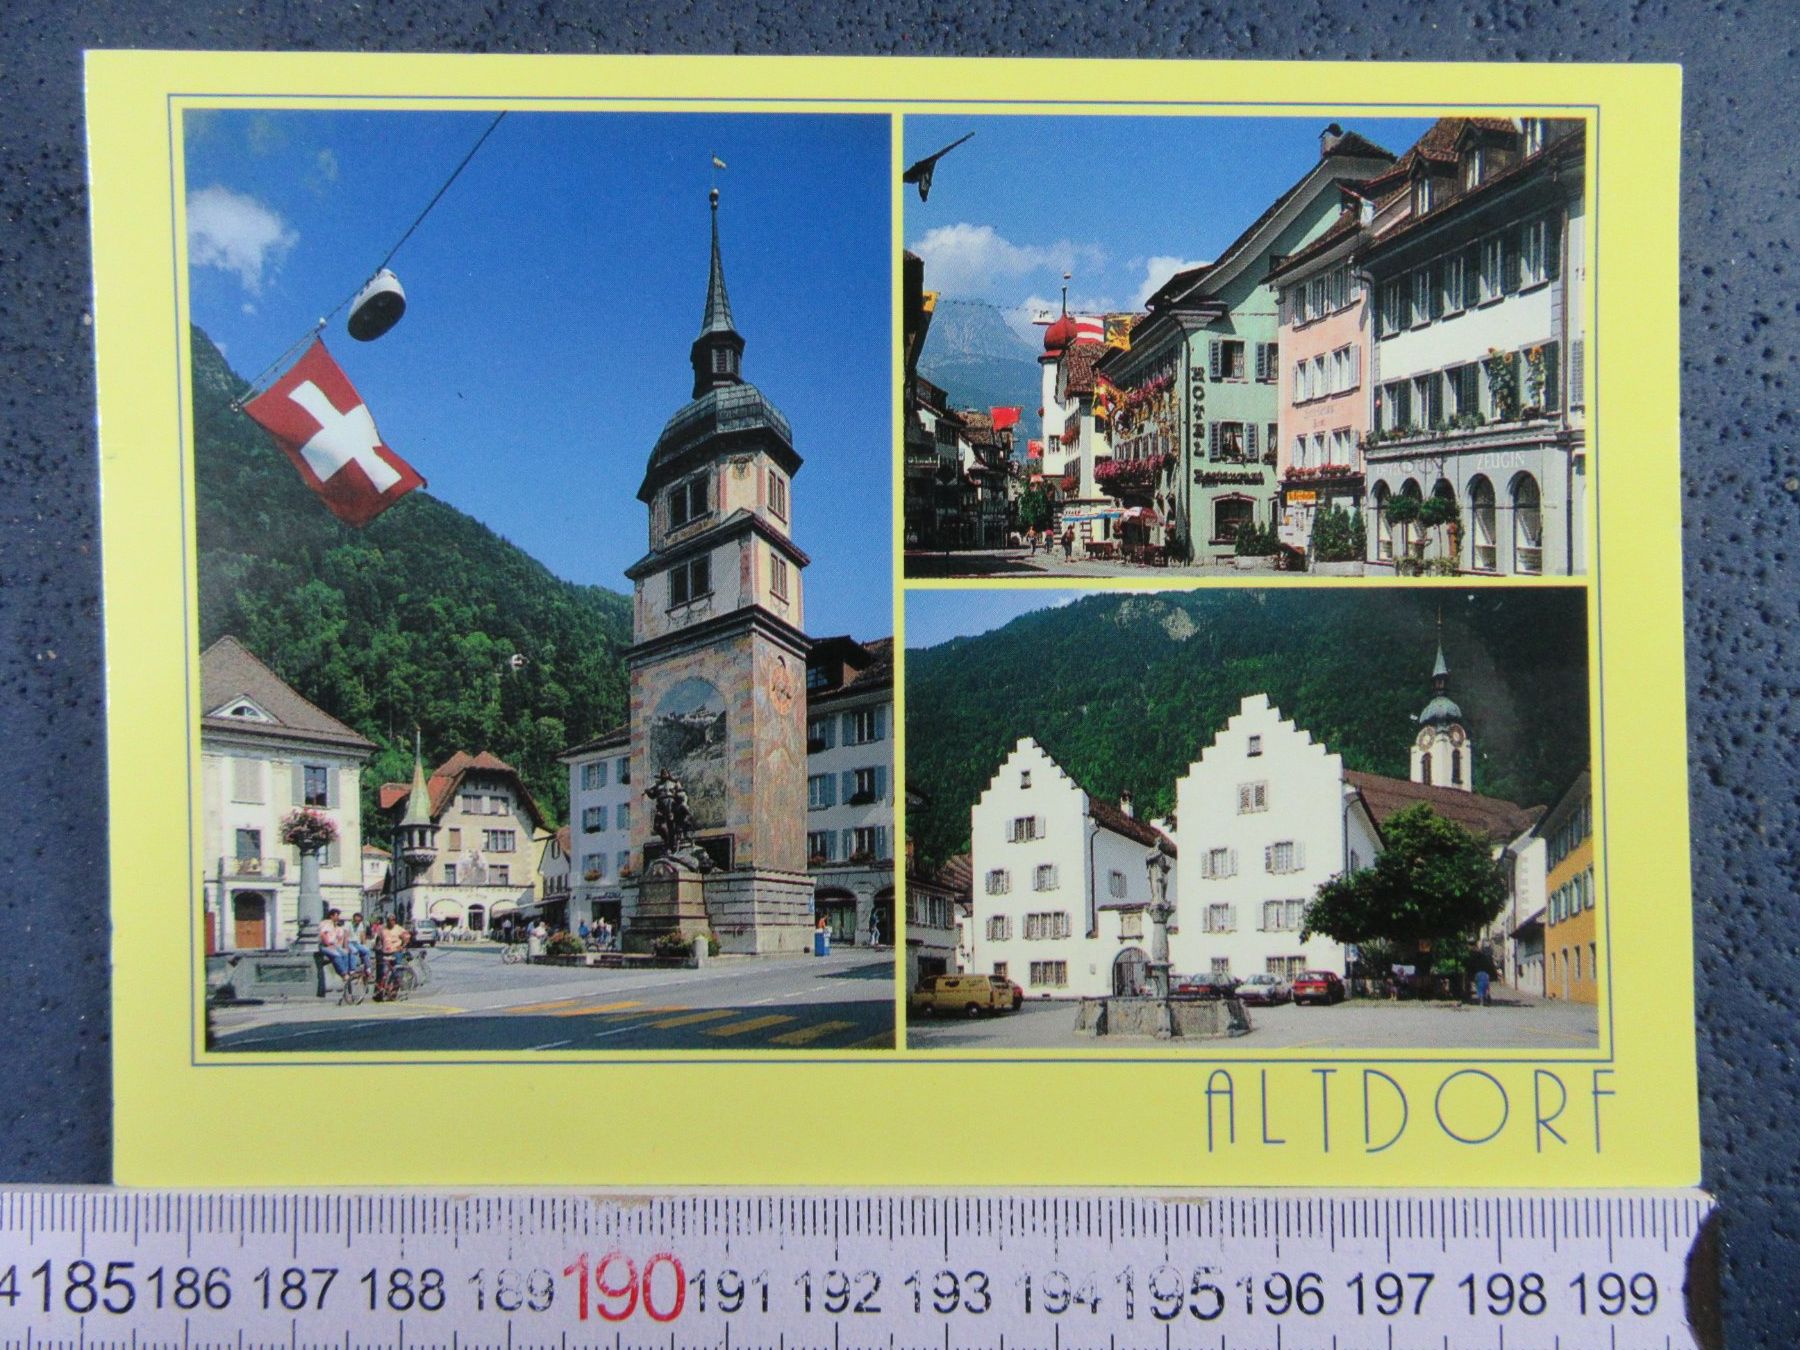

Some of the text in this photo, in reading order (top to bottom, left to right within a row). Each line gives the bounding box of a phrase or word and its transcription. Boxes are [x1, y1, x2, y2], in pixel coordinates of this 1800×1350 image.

[1191, 366, 1205, 458] HOTEL
[1204, 1067, 1617, 1154] ALTDORF
[31, 1259, 137, 1315] 185
[147, 1265, 232, 1310] 186
[253, 1266, 340, 1310] 187
[360, 1267, 447, 1312] 188
[467, 1268, 555, 1313] 189
[562, 1251, 687, 1322] 190
[689, 1269, 770, 1313] 191
[795, 1269, 882, 1314] 192
[904, 1269, 992, 1315] 193
[1013, 1271, 1102, 1315] 194
[1115, 1264, 1226, 1322] 195
[1235, 1271, 1325, 1316] 196
[1346, 1271, 1436, 1316] 197
[1457, 1271, 1548, 1316] 198
[1568, 1271, 1658, 1316] 199
